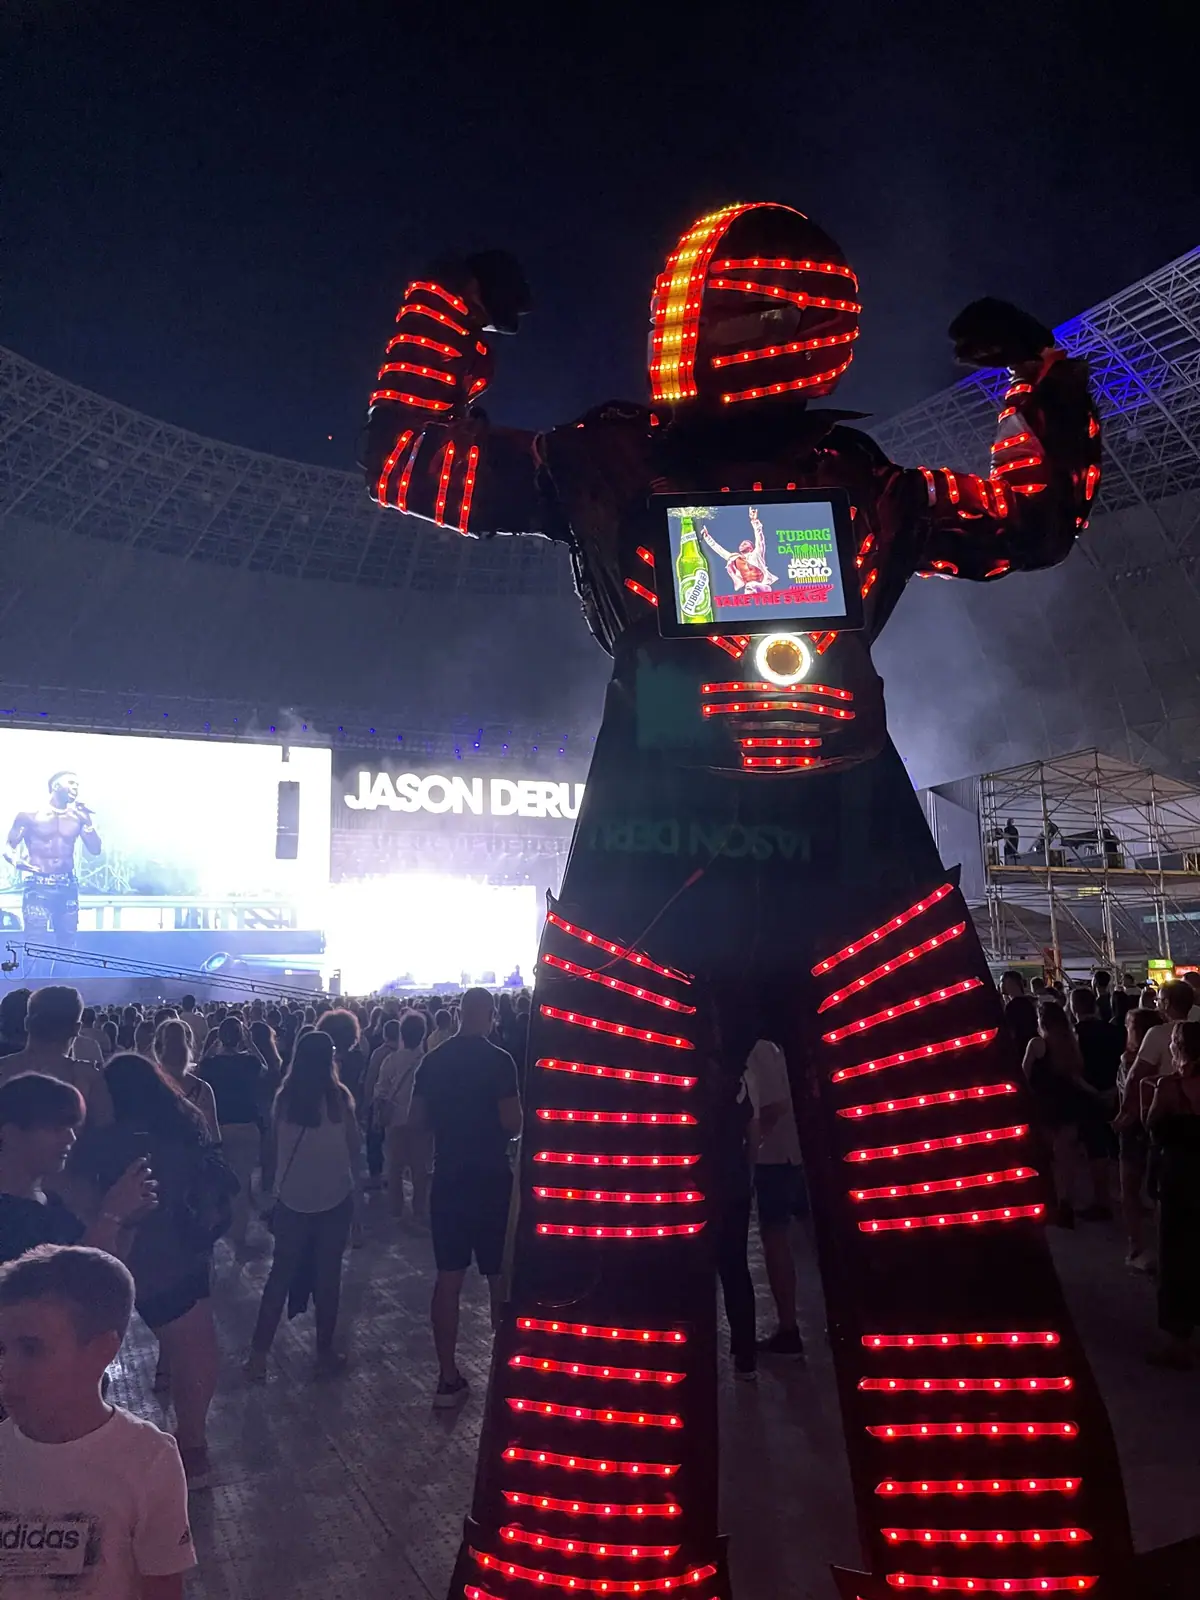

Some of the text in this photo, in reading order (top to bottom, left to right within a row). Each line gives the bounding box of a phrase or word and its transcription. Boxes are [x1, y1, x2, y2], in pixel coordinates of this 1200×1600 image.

[776, 528, 831, 543] TUBORG
[788, 557, 827, 569] JASON
[788, 567, 832, 578] DERULO
[684, 580, 706, 612] TUBORG
[714, 589, 828, 607] TAKE THE STAGE
[344, 771, 586, 819] JASON DERU
[0, 1524, 80, 1549] didas
